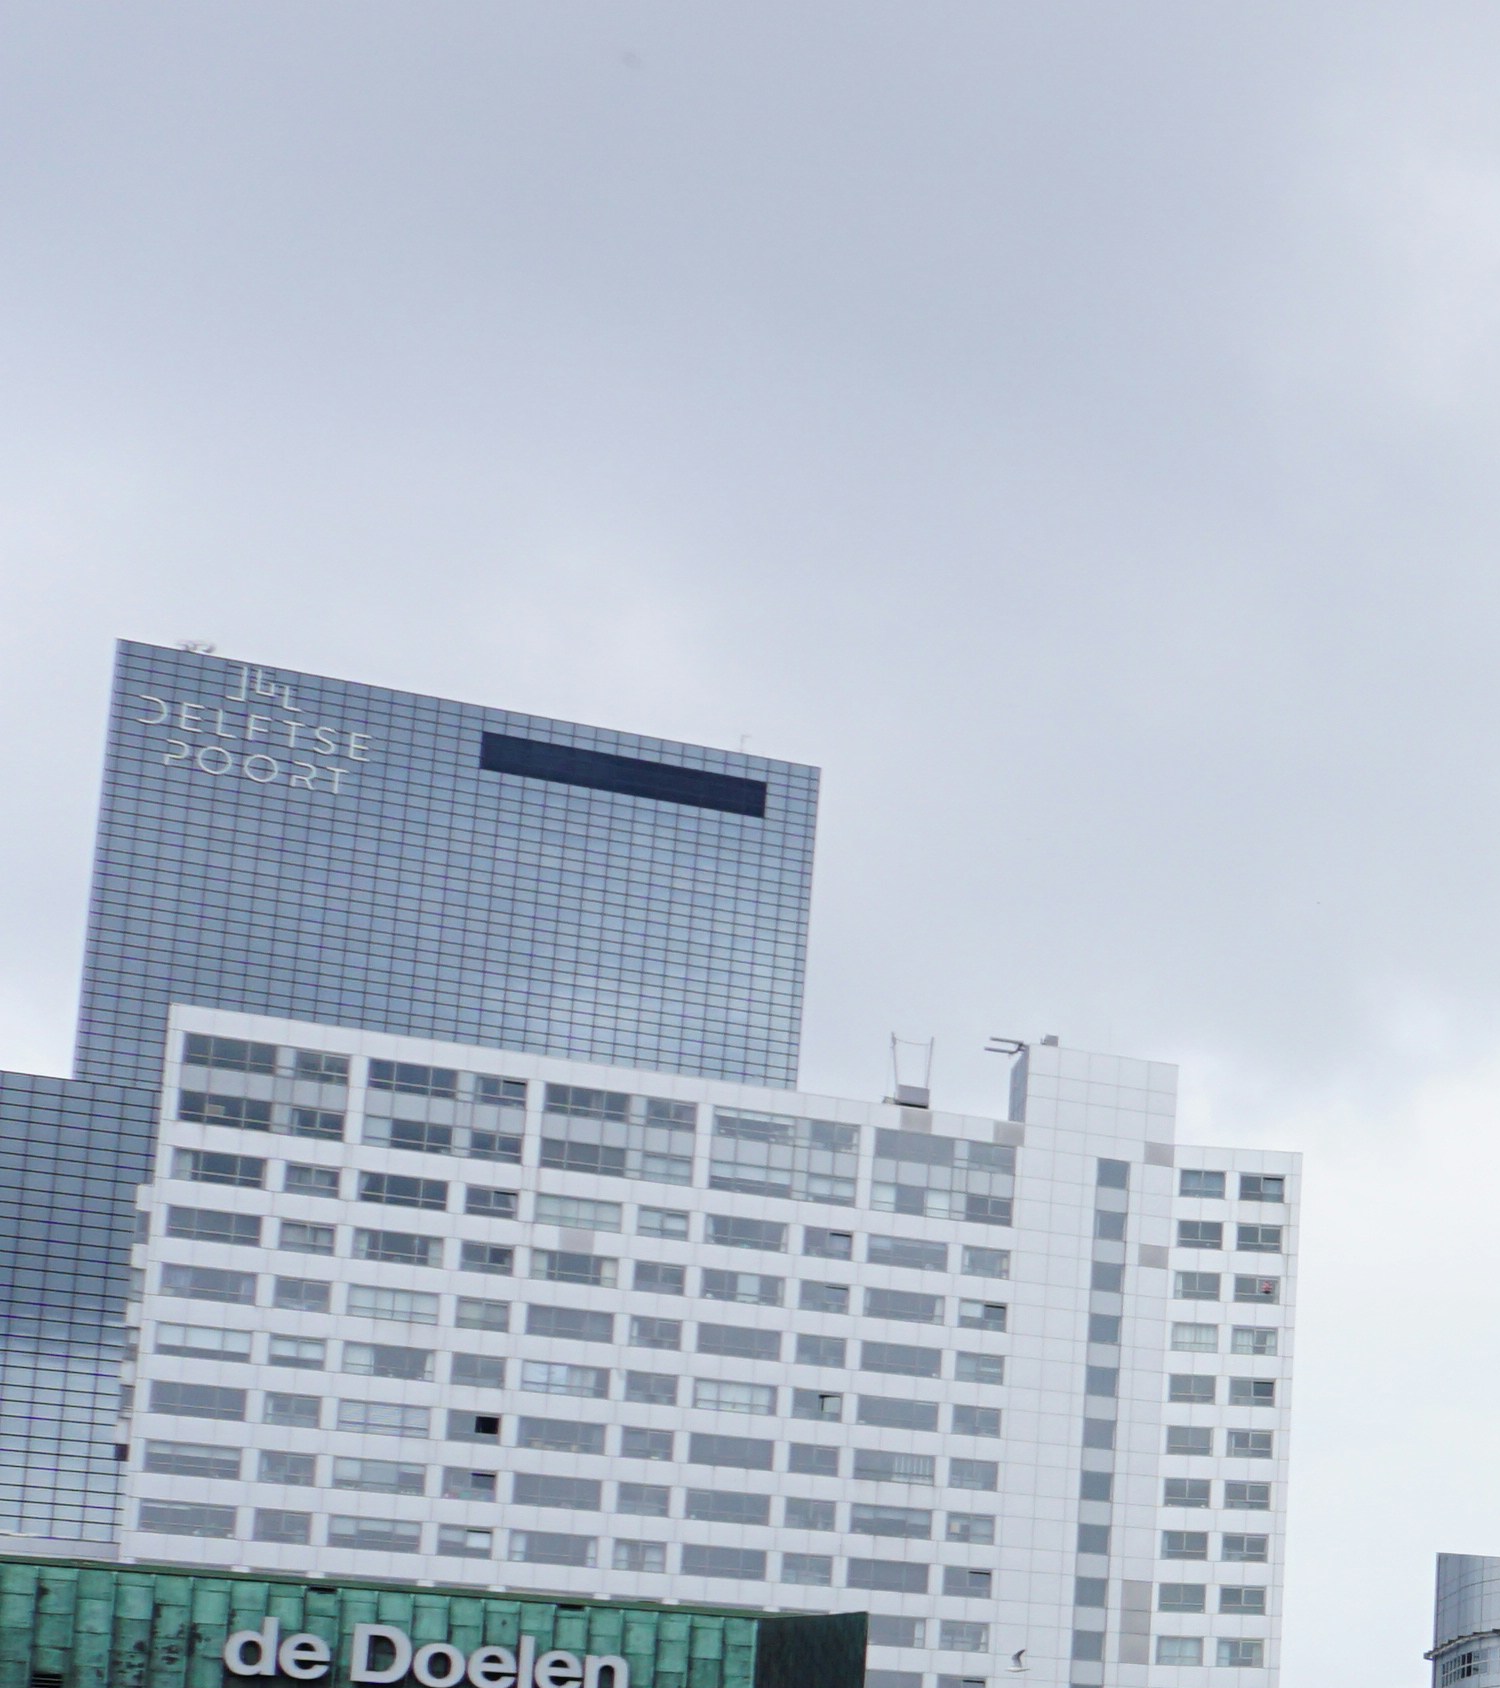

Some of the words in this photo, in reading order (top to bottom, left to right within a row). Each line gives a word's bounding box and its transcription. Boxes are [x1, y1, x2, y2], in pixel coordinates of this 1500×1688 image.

[136, 694, 374, 763] DELFTSE
[163, 738, 350, 795] POORT
[223, 1617, 330, 1680] de
